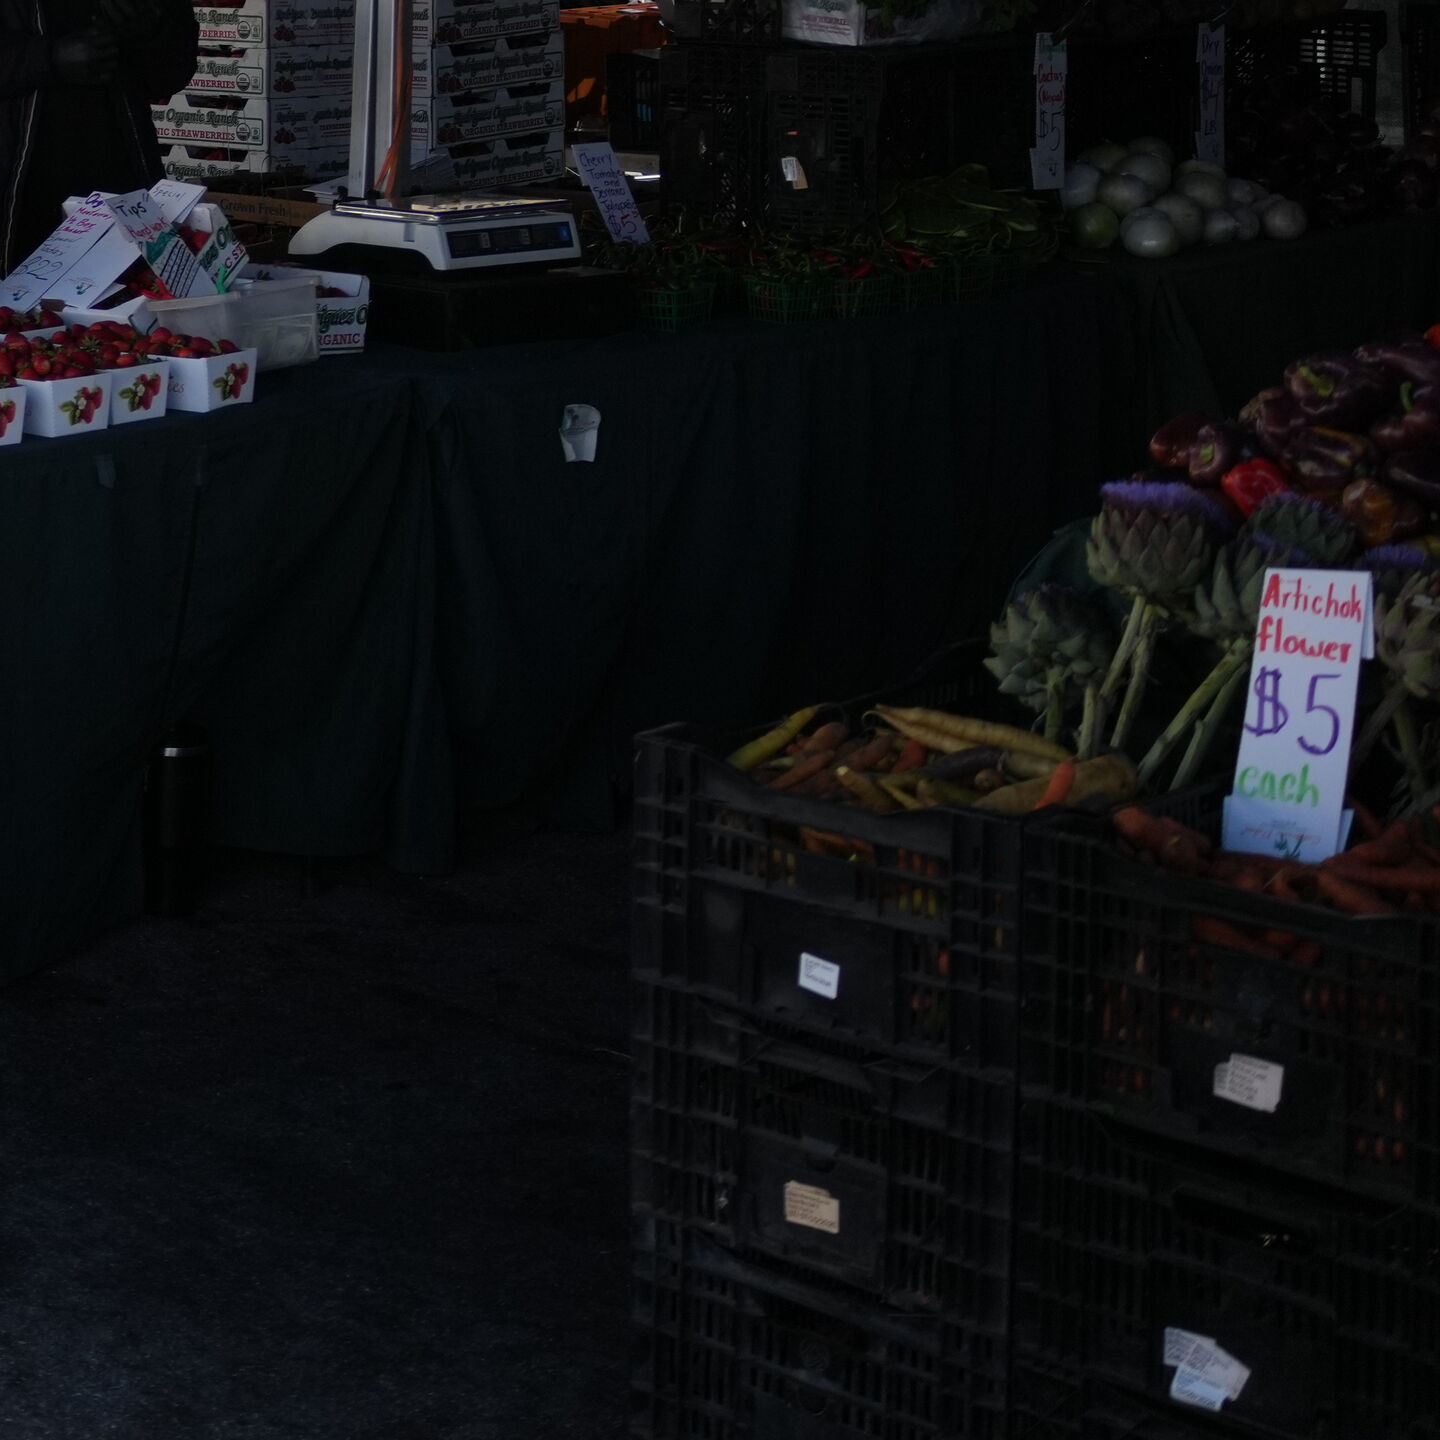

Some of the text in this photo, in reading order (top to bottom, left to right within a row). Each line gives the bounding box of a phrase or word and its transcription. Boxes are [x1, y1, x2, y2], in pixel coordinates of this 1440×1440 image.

[206, 10, 240, 28] Ranch
[206, 61, 240, 79] Ranch
[187, 78, 237, 90] AWBERRIES
[166, 108, 240, 131] Organic Ranch
[171, 126, 236, 142] STRAWBERRIES
[167, 160, 206, 178] Organic
[579, 152, 614, 173] Cherry
[220, 198, 286, 217] Grown Fresh
[1260, 572, 1364, 623] Artichok
[1256, 616, 1352, 663] flower
[1236, 762, 1321, 808] each
